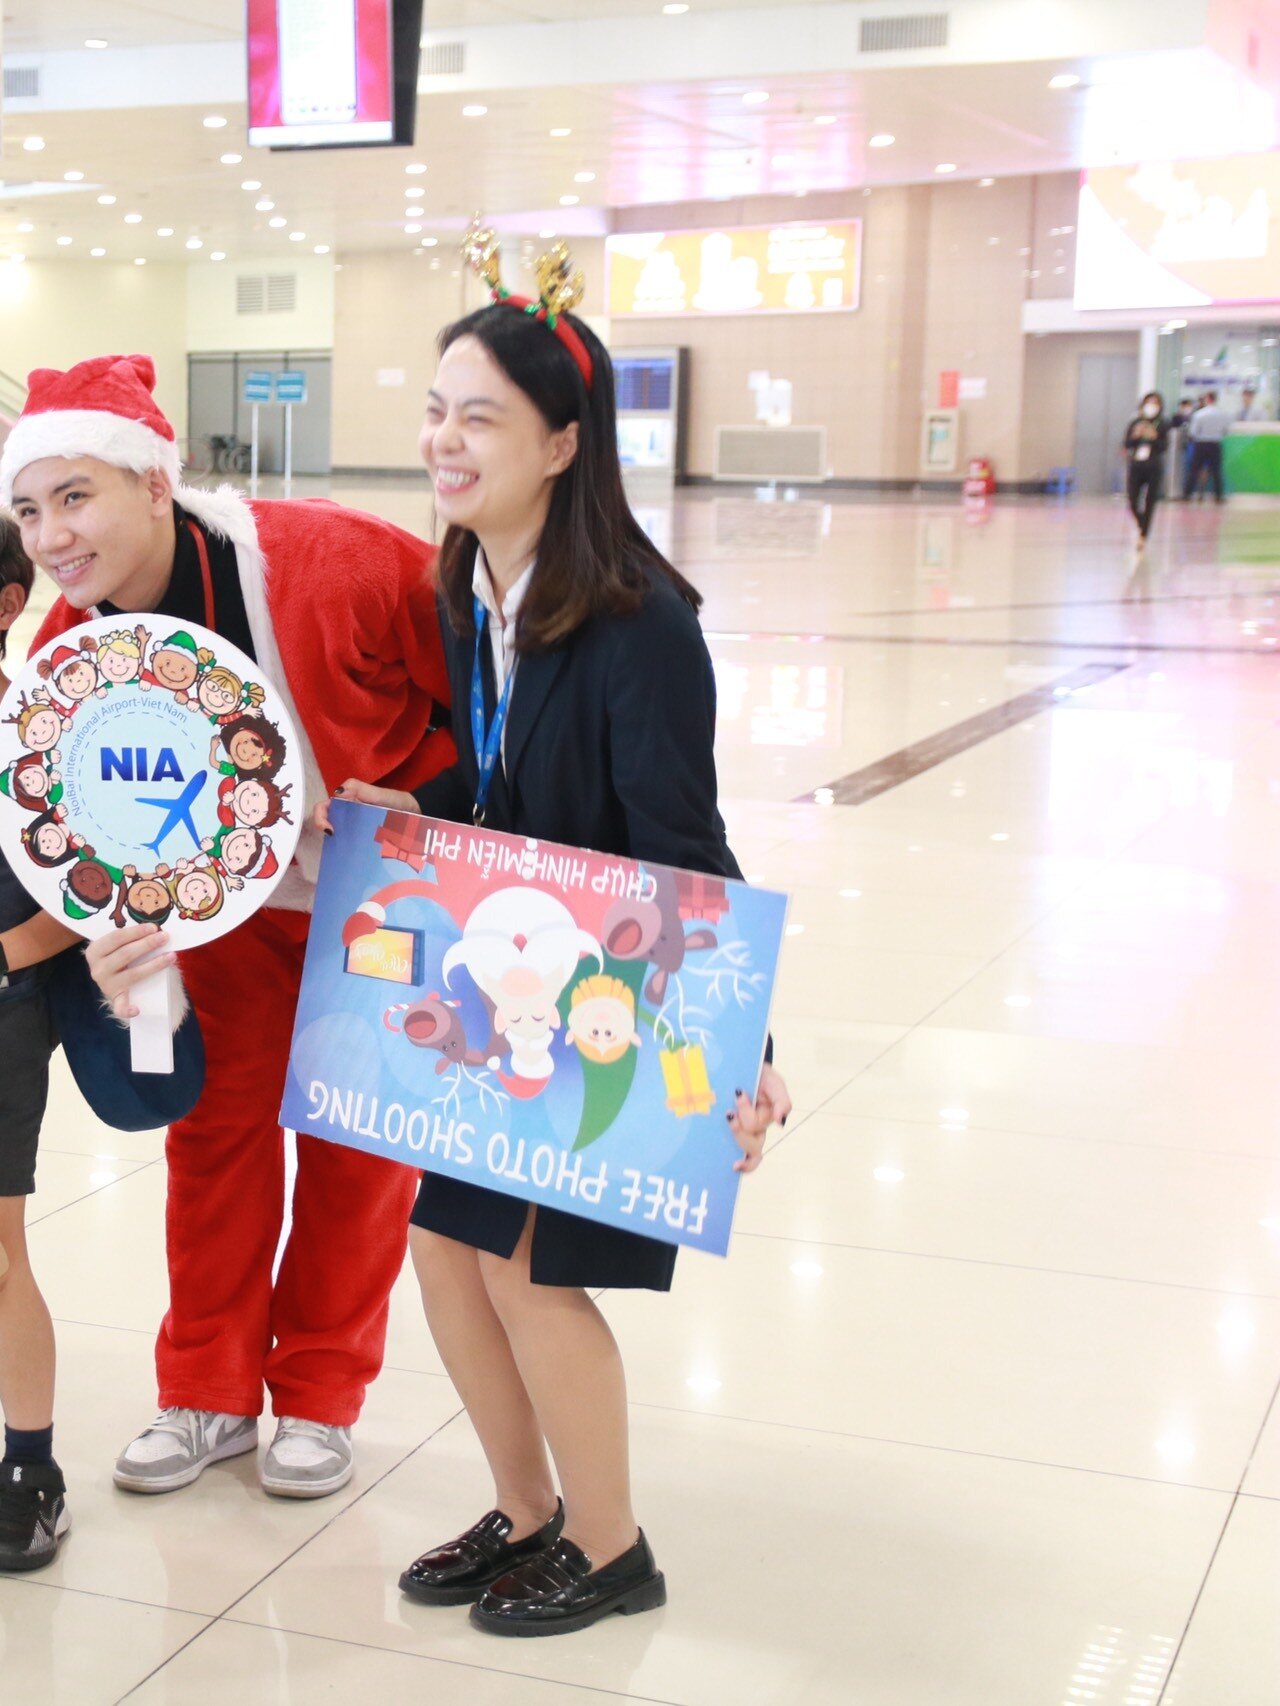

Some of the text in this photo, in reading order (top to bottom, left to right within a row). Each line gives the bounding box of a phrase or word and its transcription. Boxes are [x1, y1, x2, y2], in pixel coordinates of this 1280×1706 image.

[65, 712, 101, 778] International
[164, 702, 188, 723] Nam
[100, 747, 185, 782] NIA
[422, 829, 461, 861] PHÍ
[591, 864, 657, 903] CHỤP
[307, 1080, 708, 1235] FREE PHOTO SHOOTING
